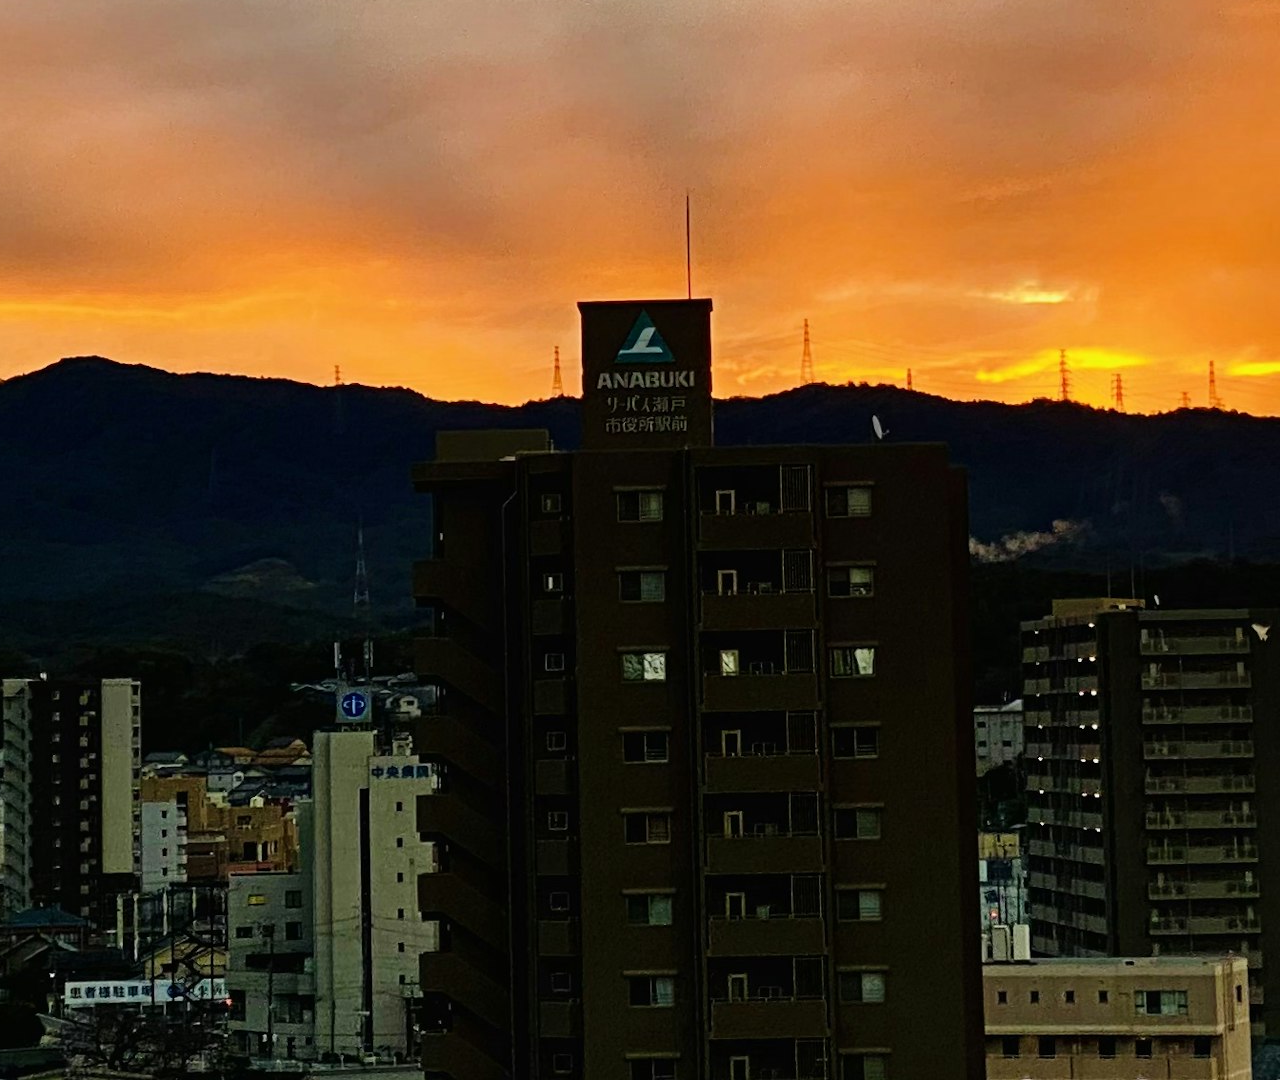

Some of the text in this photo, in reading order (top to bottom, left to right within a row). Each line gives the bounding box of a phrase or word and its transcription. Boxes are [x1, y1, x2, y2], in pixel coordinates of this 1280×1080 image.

[597, 371, 695, 389] ANABUKI
[605, 416, 688, 433] 市役所駅前
